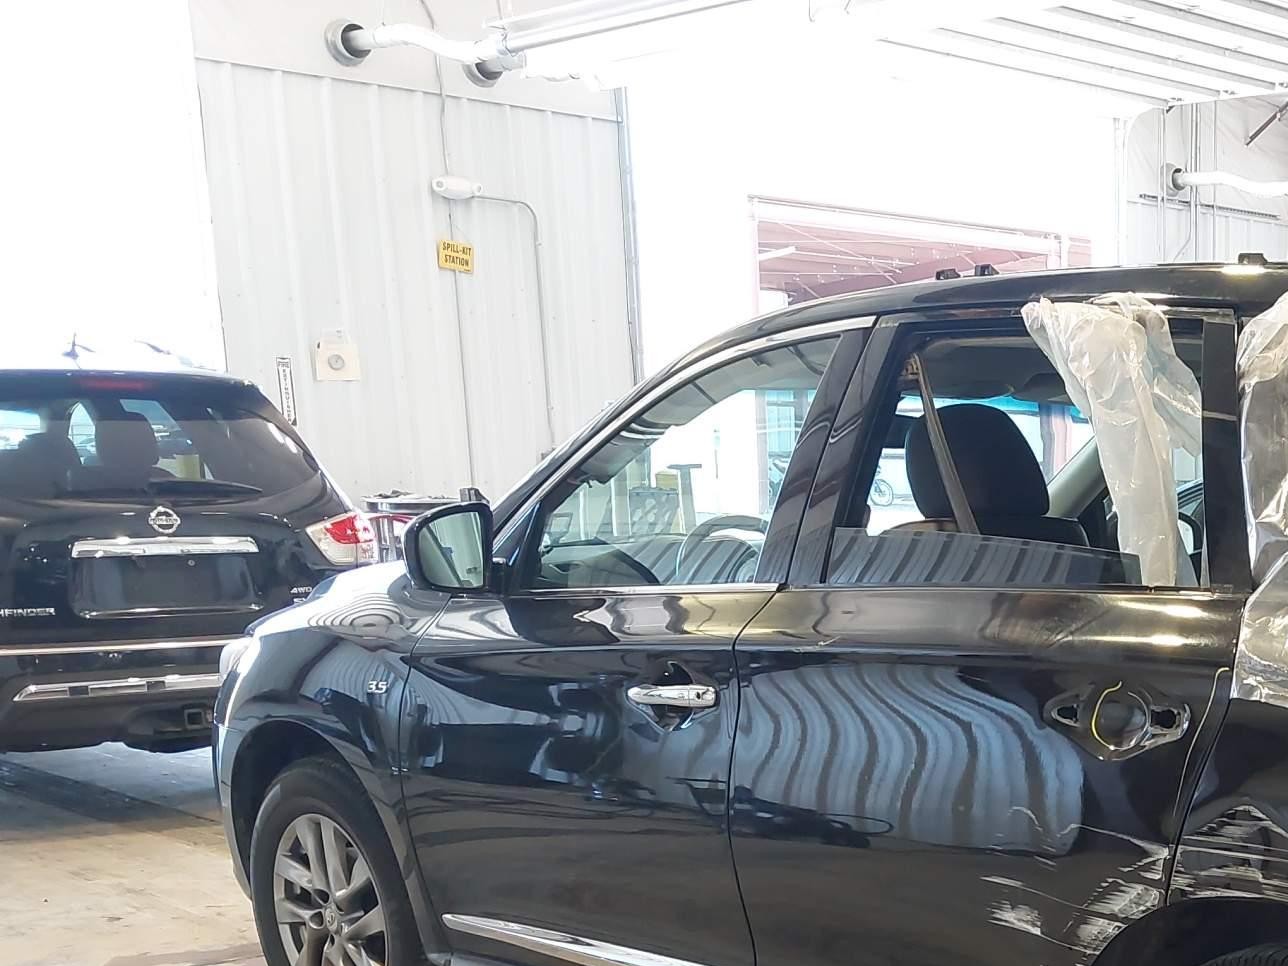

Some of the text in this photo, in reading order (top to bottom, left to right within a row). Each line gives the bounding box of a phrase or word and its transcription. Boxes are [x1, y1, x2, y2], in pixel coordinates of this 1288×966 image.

[442, 241, 472, 256] SPILL-KIT
[444, 255, 470, 267] STATION
[290, 586, 313, 594] AWD
